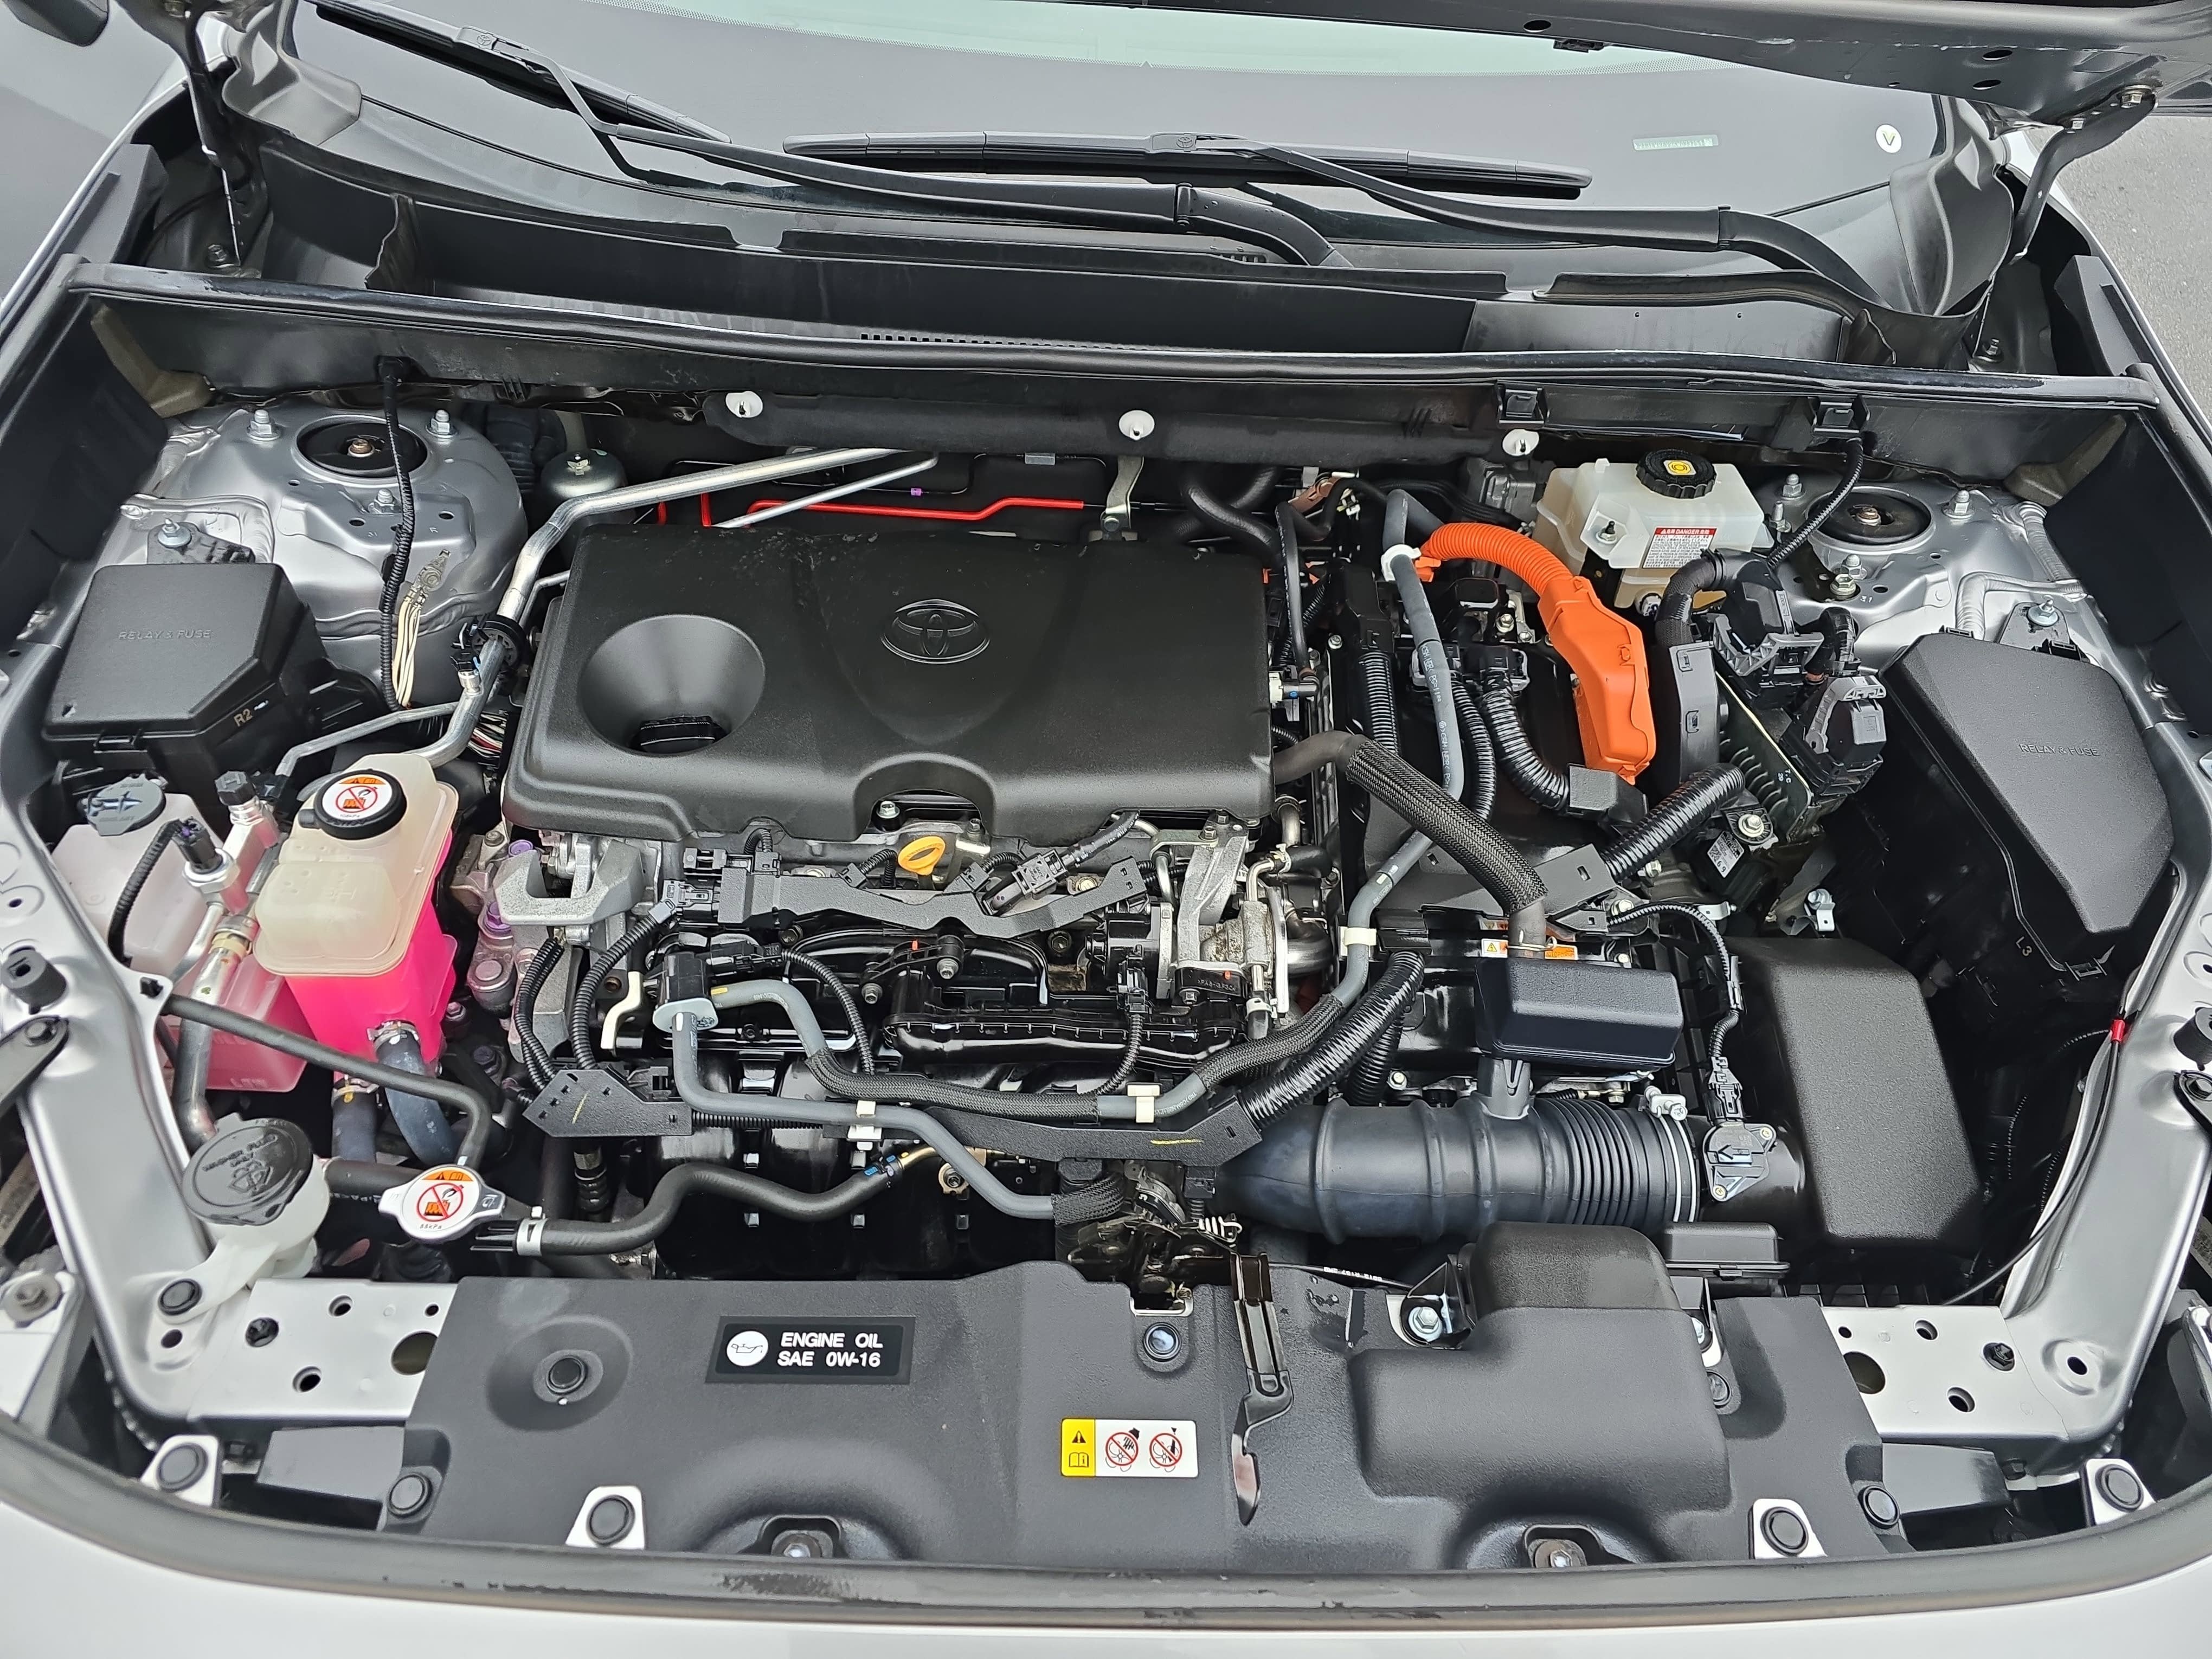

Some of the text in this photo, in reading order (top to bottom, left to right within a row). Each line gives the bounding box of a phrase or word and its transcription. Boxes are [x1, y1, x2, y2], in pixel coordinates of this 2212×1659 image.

[118, 631, 163, 640] RELAY
[177, 629, 212, 639] FUSE
[234, 708, 253, 726] R2
[2019, 744, 2100, 756] RELAY & FUSE
[2016, 936, 2033, 956] L3
[780, 1332, 883, 1349] ENGINE OIL
[777, 1350, 881, 1367] SAE 0W-16
